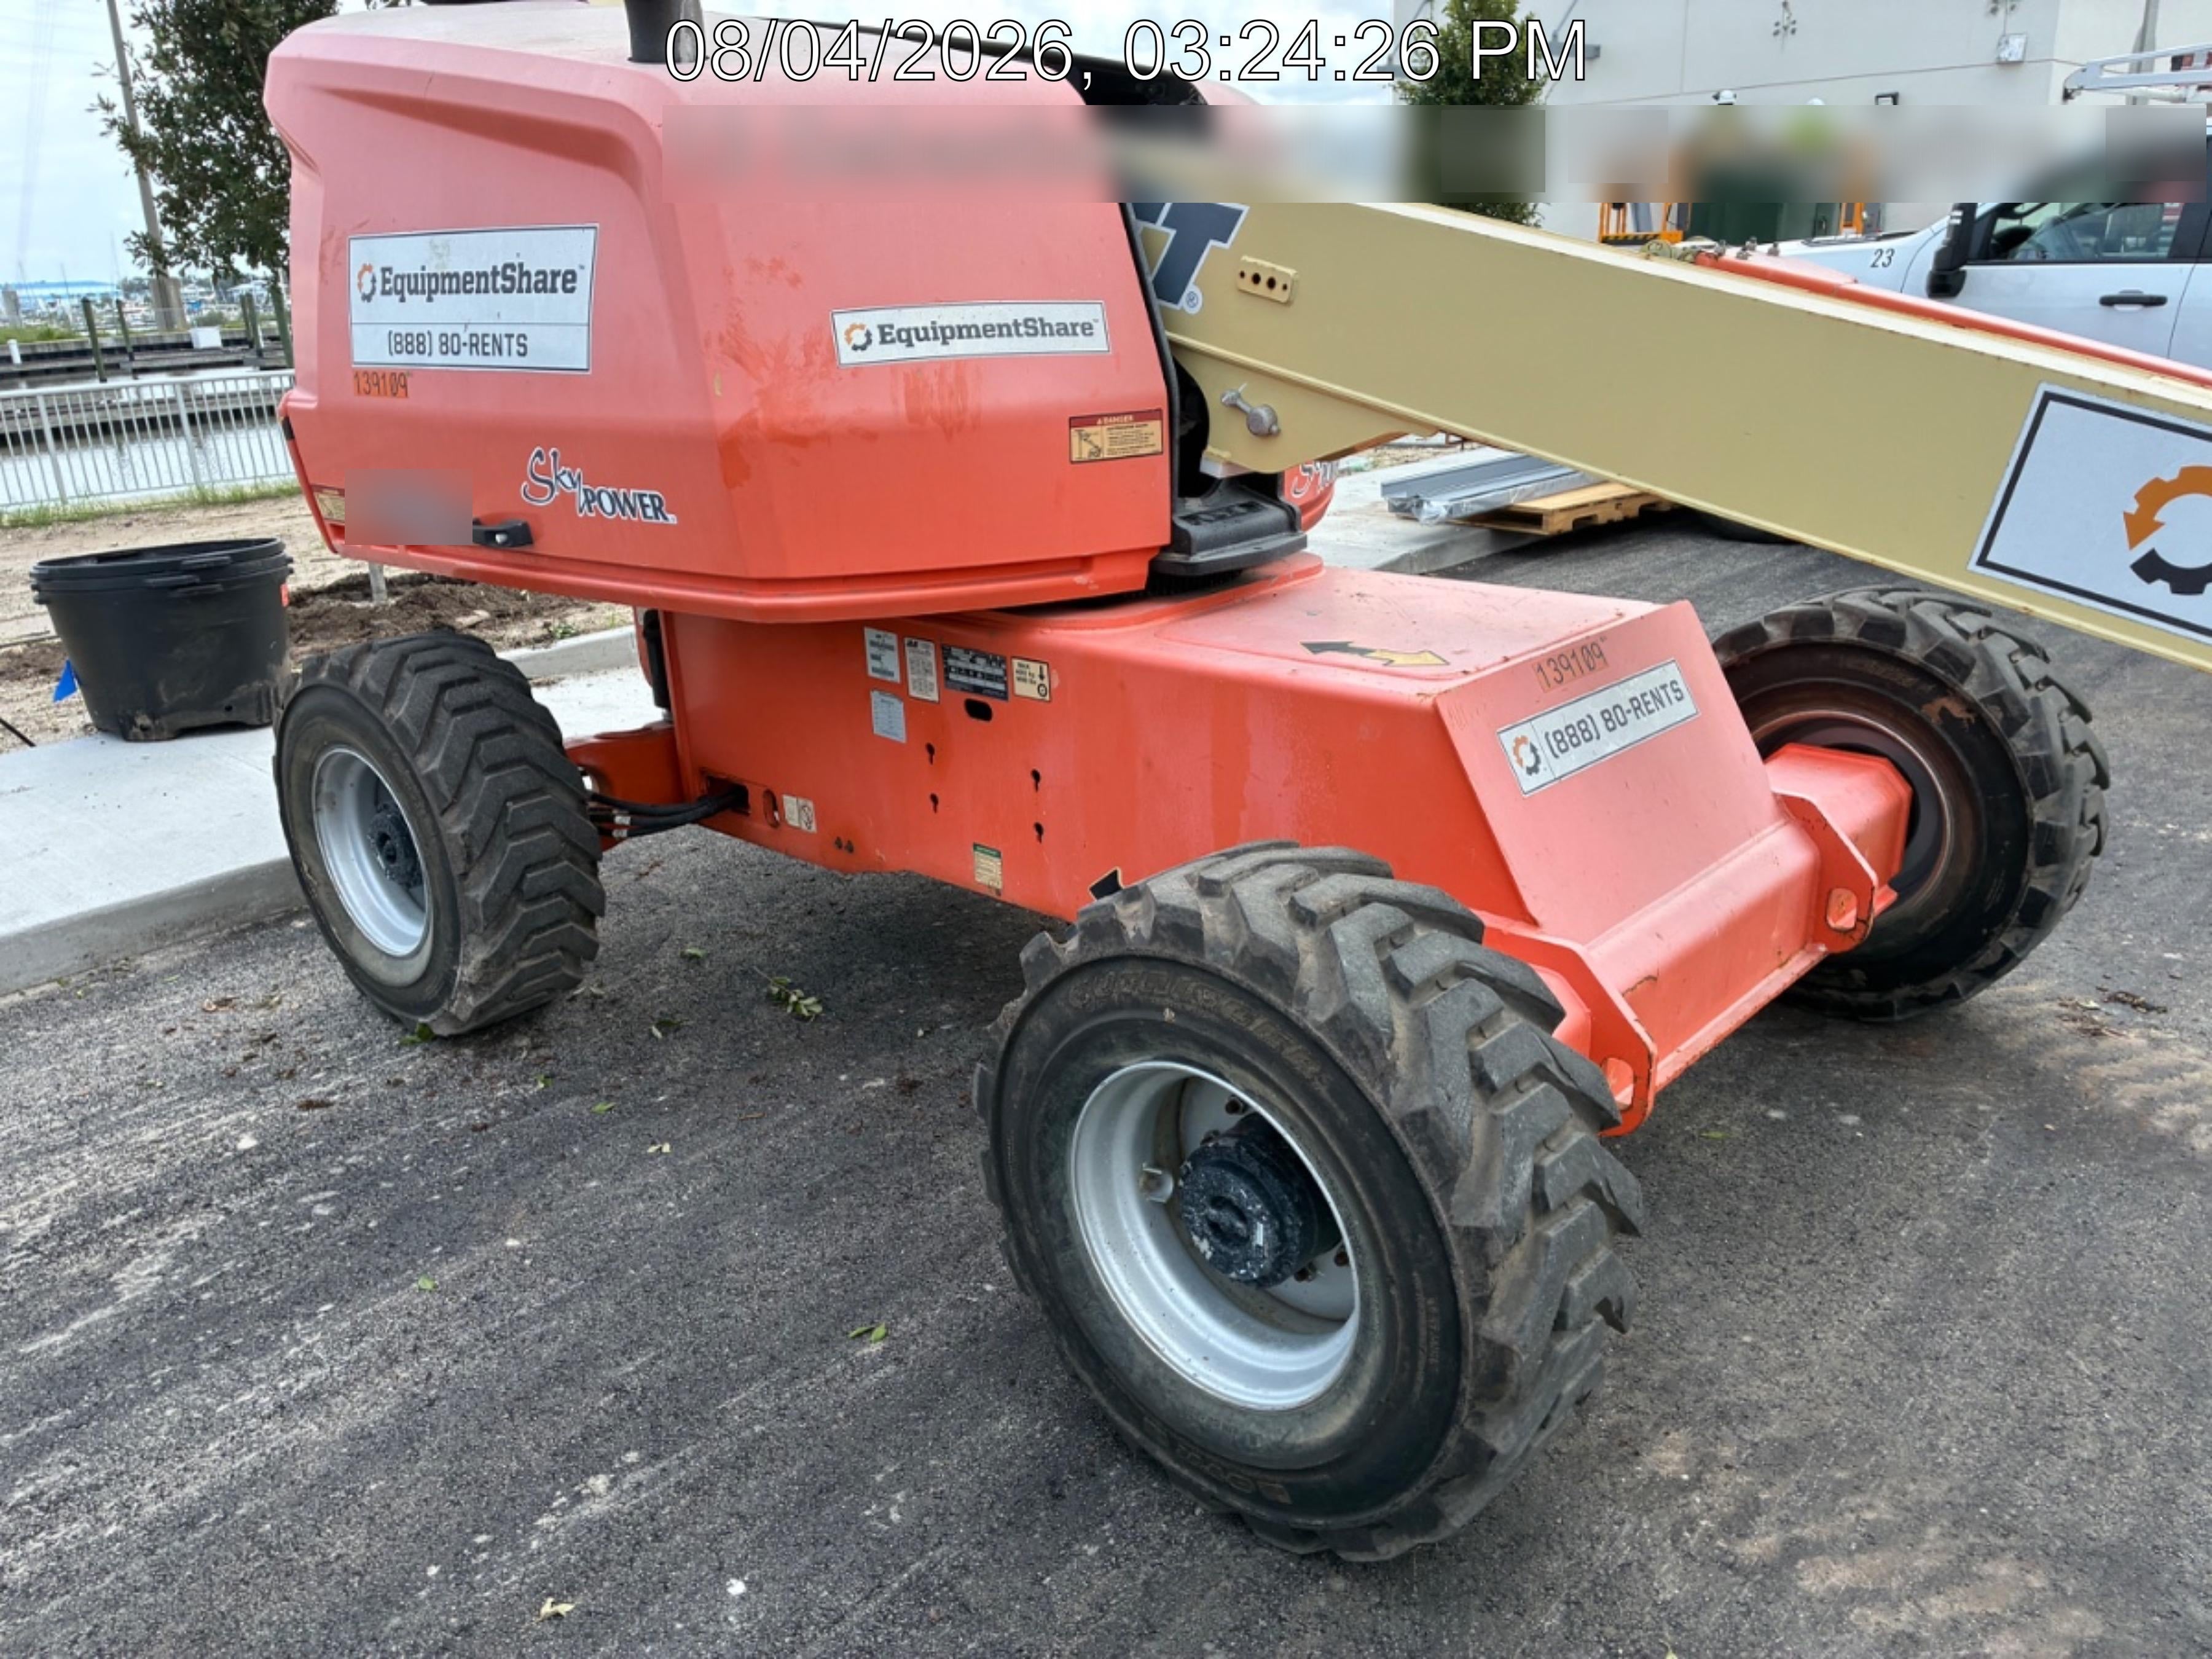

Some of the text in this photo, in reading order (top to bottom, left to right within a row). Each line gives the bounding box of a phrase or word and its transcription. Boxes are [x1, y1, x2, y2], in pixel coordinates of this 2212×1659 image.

[1870, 248, 1896, 268] 23
[380, 262, 578, 302] EquipmentShare
[388, 330, 528, 358] (888) 80-RENTS
[876, 316, 1095, 347] EquipmentShare
[353, 370, 409, 398] 139109
[1537, 641, 1609, 688] 139109
[1544, 679, 1685, 759] (888) 80-RENTS
